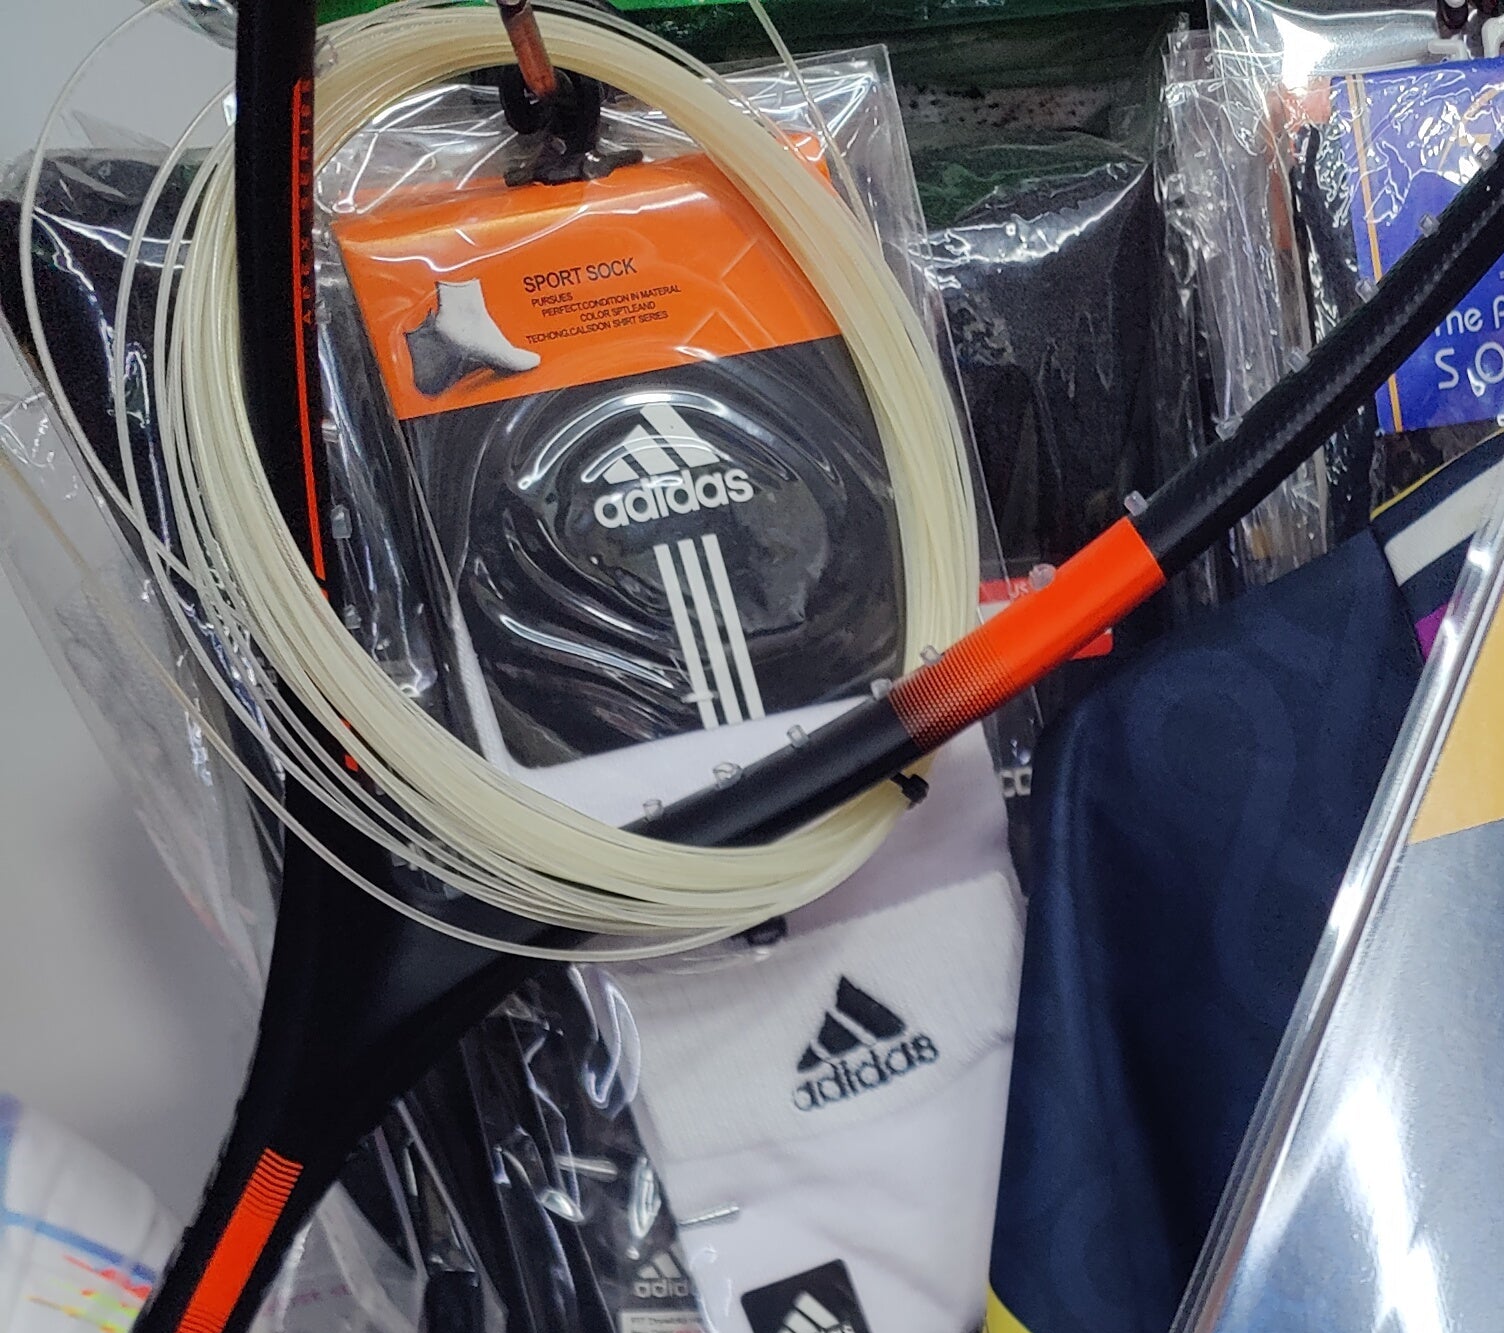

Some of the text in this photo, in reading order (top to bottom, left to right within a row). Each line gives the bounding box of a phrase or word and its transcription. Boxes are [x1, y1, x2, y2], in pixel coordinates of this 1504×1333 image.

[523, 257, 638, 293] SPORT SOCK
[531, 292, 574, 308] PURSUES
[1434, 307, 1484, 337] he
[594, 468, 754, 529] adidas
[793, 1032, 940, 1114] adidas
